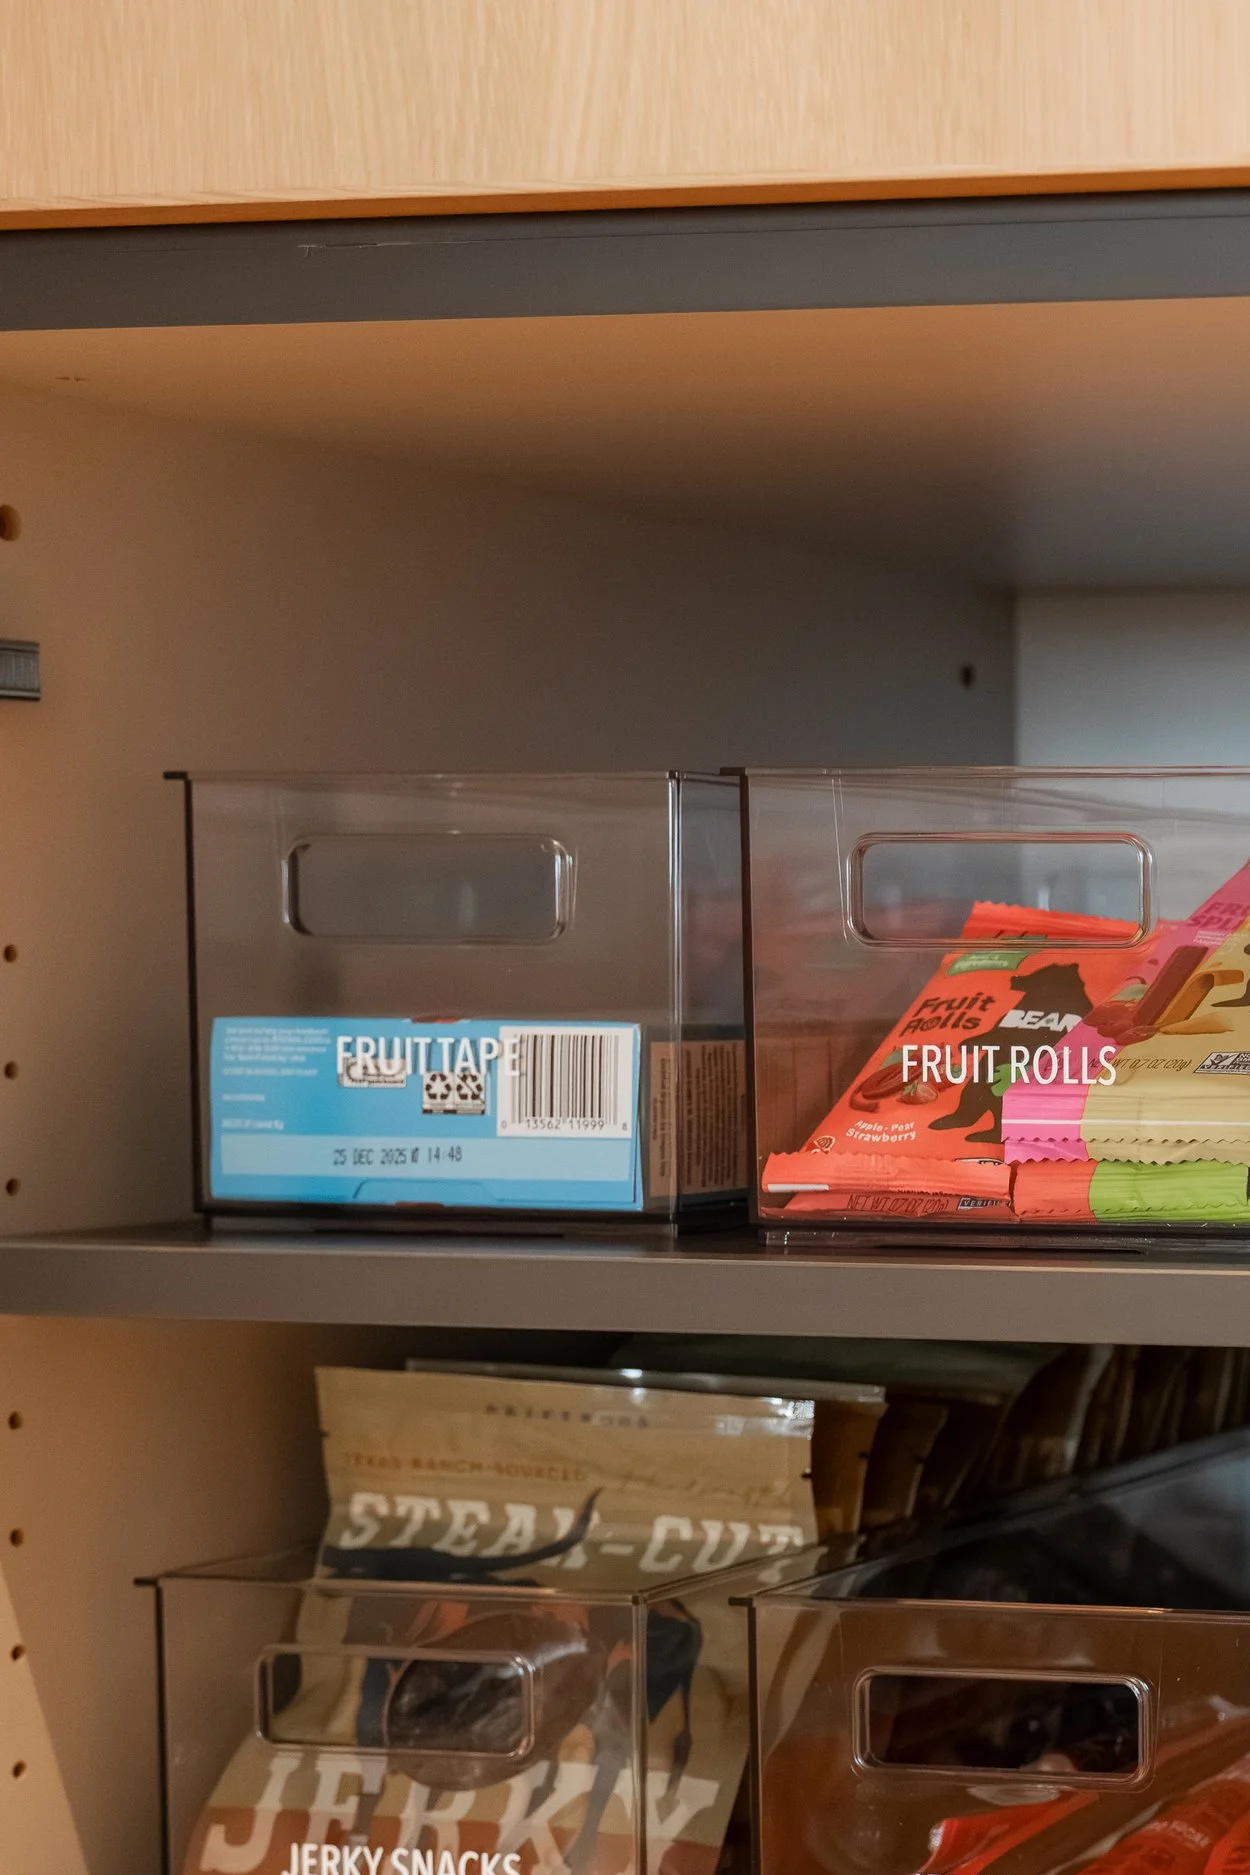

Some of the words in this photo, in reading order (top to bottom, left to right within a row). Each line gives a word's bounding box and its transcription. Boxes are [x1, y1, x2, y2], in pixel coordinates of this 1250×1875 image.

[914, 991, 997, 1017] Fruit
[337, 1035, 430, 1076] FRUIT
[438, 1036, 521, 1077] TAPE
[902, 1044, 1000, 1084] FRUIT
[1010, 1045, 1117, 1085] ROLLS
[526, 1118, 561, 1130] 13562
[567, 1118, 605, 1130] 11999
[845, 1128, 917, 1143] Strawberry
